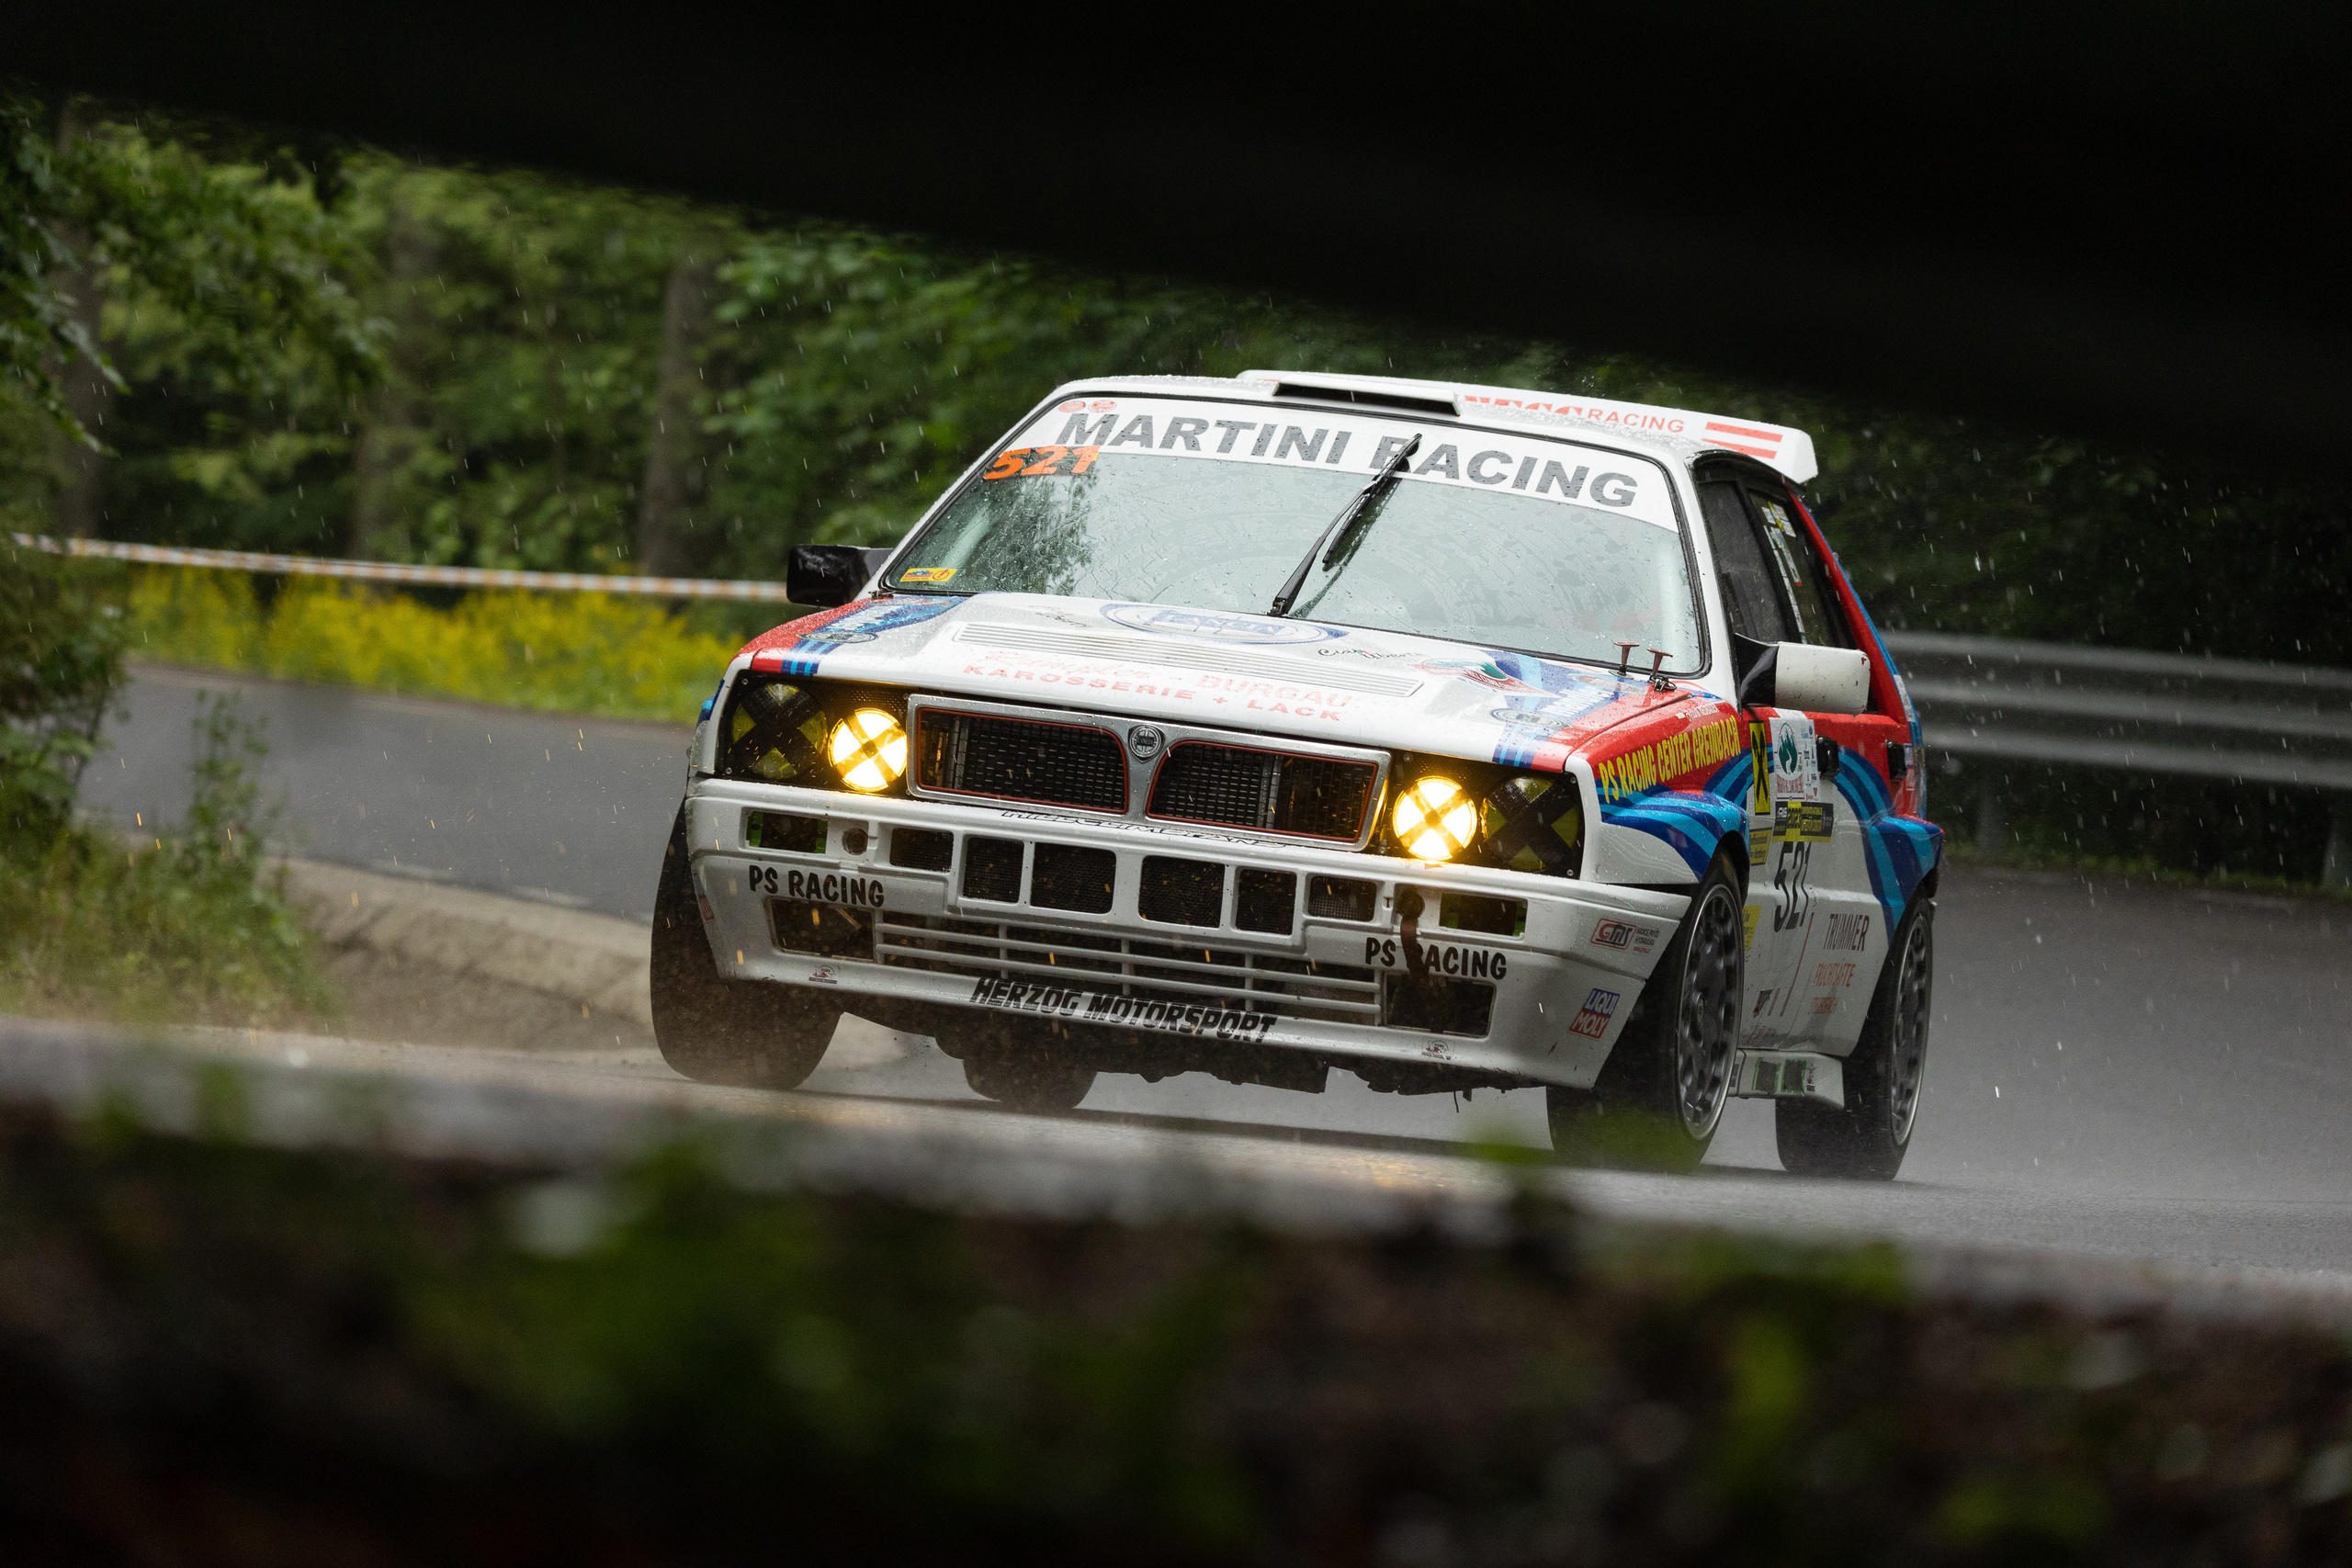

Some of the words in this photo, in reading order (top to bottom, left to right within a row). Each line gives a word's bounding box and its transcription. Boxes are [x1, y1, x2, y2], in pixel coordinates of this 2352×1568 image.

[1586, 407, 1685, 434] RACING
[983, 444, 1102, 479] 521
[1056, 412, 1353, 467] MARTINI
[1369, 434, 1638, 507] RACING
[963, 664, 1194, 701] KAROSSERIE
[1246, 699, 1342, 722] LACK
[1193, 674, 1353, 708] BURGAU
[1598, 760, 1620, 804] PS
[1616, 745, 1657, 797] RACING
[1656, 734, 1693, 783] CENTER
[749, 864, 779, 895] PS
[787, 869, 885, 908] RACING
[1773, 840, 1812, 933] 521
[1364, 936, 1396, 967] PS
[1823, 912, 1870, 952] TRUMMER
[967, 976, 1083, 1017] HERZOG
[1082, 991, 1278, 1043] MOTORSPORT
[1584, 989, 1619, 1015] LIQUI
[1572, 1010, 1610, 1039] MOLY
